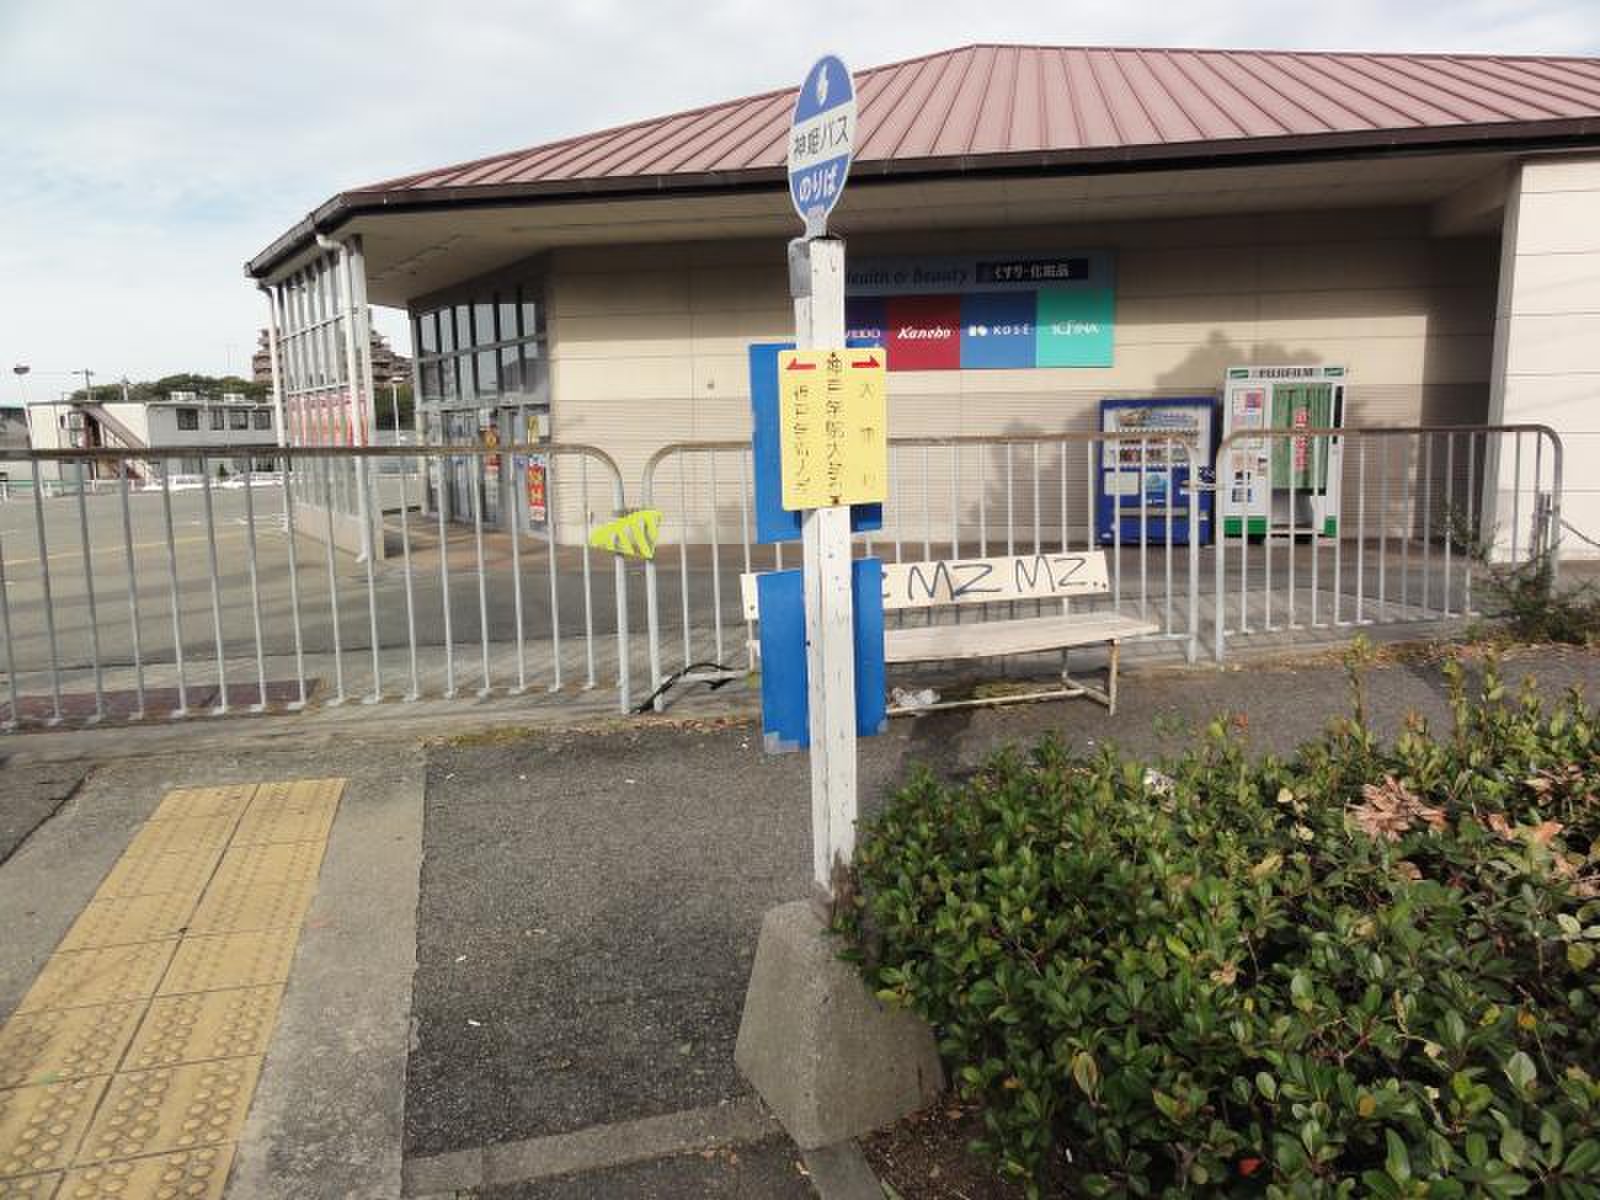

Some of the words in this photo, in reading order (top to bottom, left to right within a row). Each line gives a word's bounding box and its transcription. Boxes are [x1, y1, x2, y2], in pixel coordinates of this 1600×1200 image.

[793, 115, 849, 157] 神姫バス
[799, 164, 839, 202] のりば
[896, 325, 952, 340] Kanebo
[907, 560, 1003, 602] MZ
